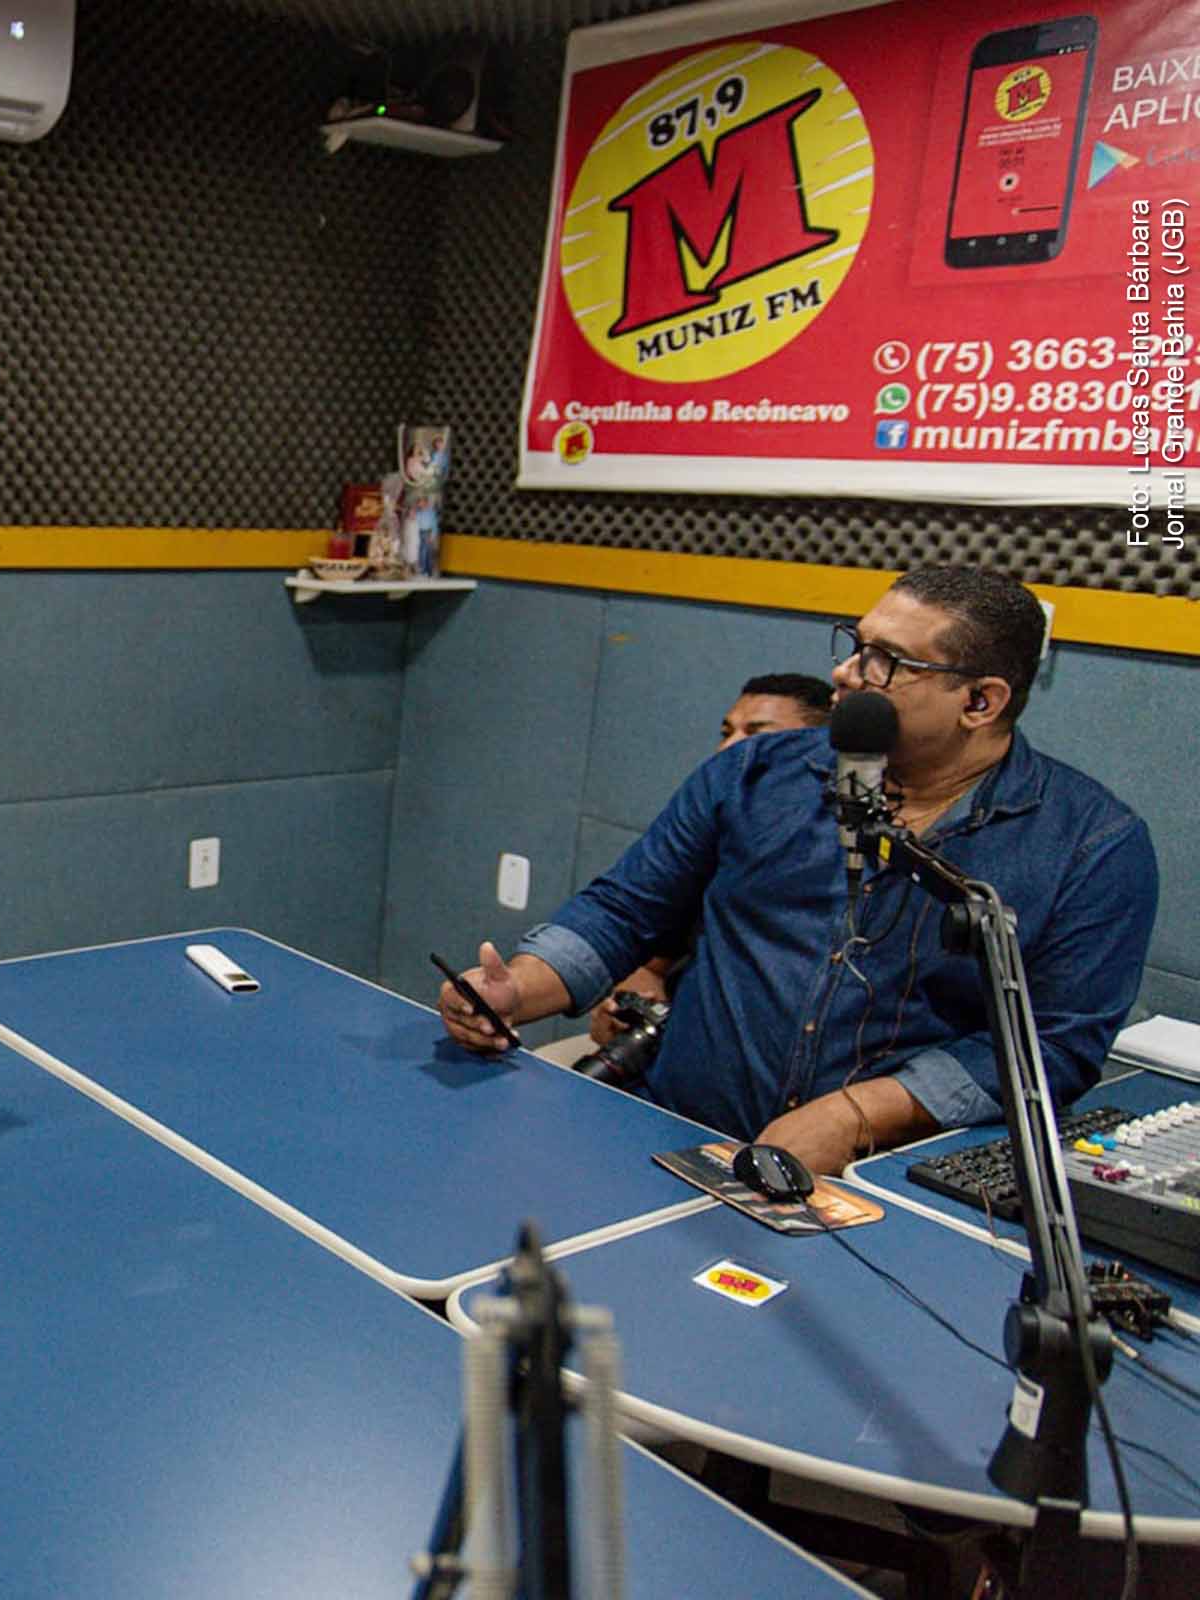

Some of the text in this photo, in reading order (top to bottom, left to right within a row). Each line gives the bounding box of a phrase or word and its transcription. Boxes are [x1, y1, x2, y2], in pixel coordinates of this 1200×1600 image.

[649, 78, 744, 146] 87,9
[637, 281, 821, 362] MUNIZ FM
[916, 335, 1200, 381] (75) 3663-22
[539, 398, 850, 425] A Caçulinha do Recôncavo
